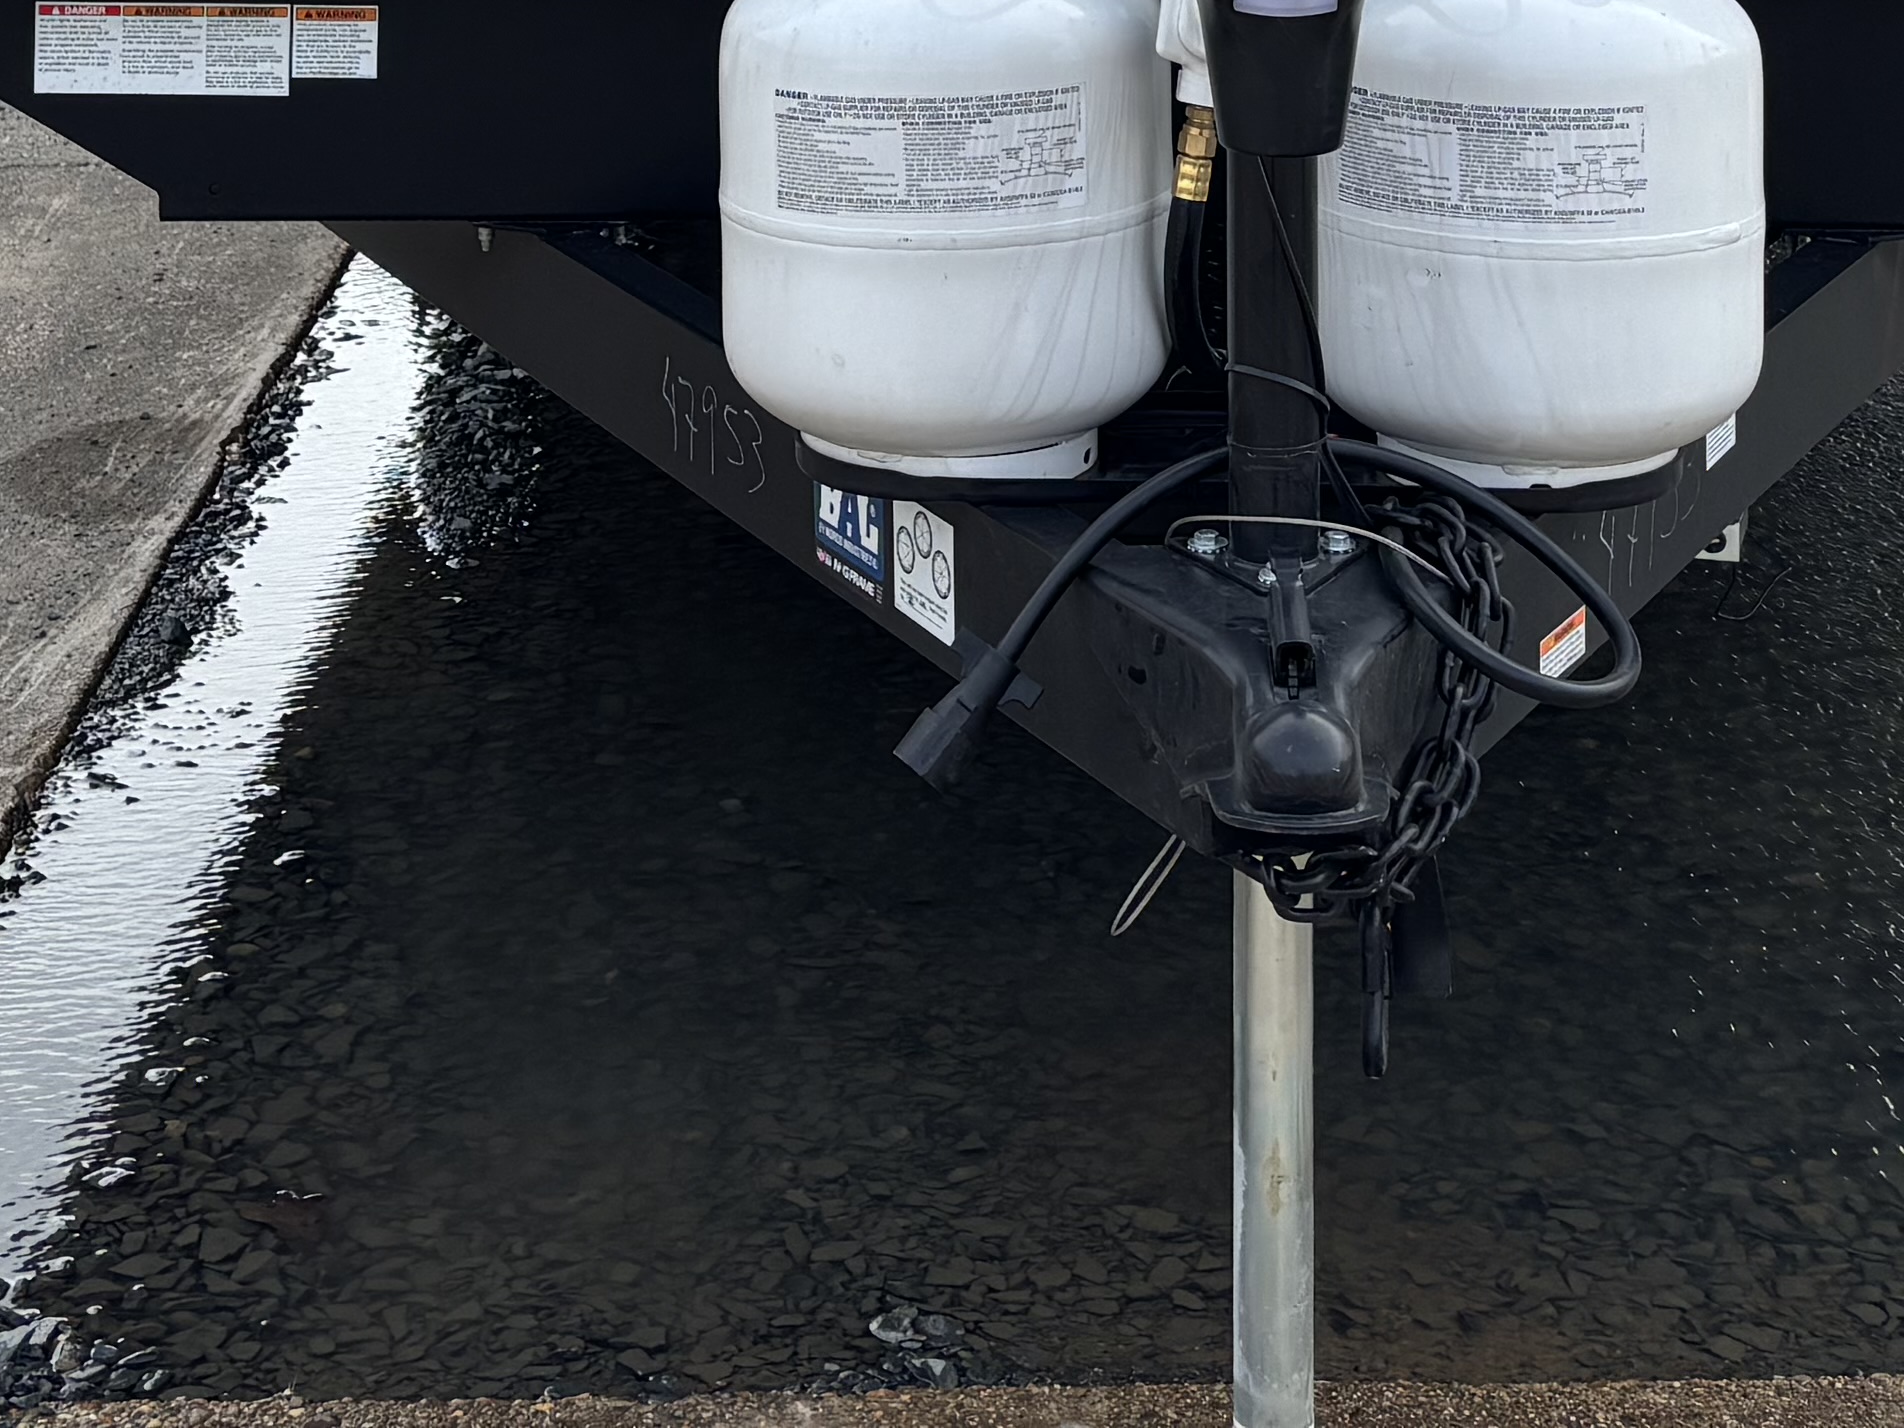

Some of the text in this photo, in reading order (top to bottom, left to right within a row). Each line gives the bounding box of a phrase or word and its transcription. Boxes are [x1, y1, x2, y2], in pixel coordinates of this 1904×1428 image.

[64, 6, 107, 15] DANGER
[316, 8, 366, 20] WARNING
[775, 88, 809, 100] DANGER
[662, 356, 766, 493] 47953
